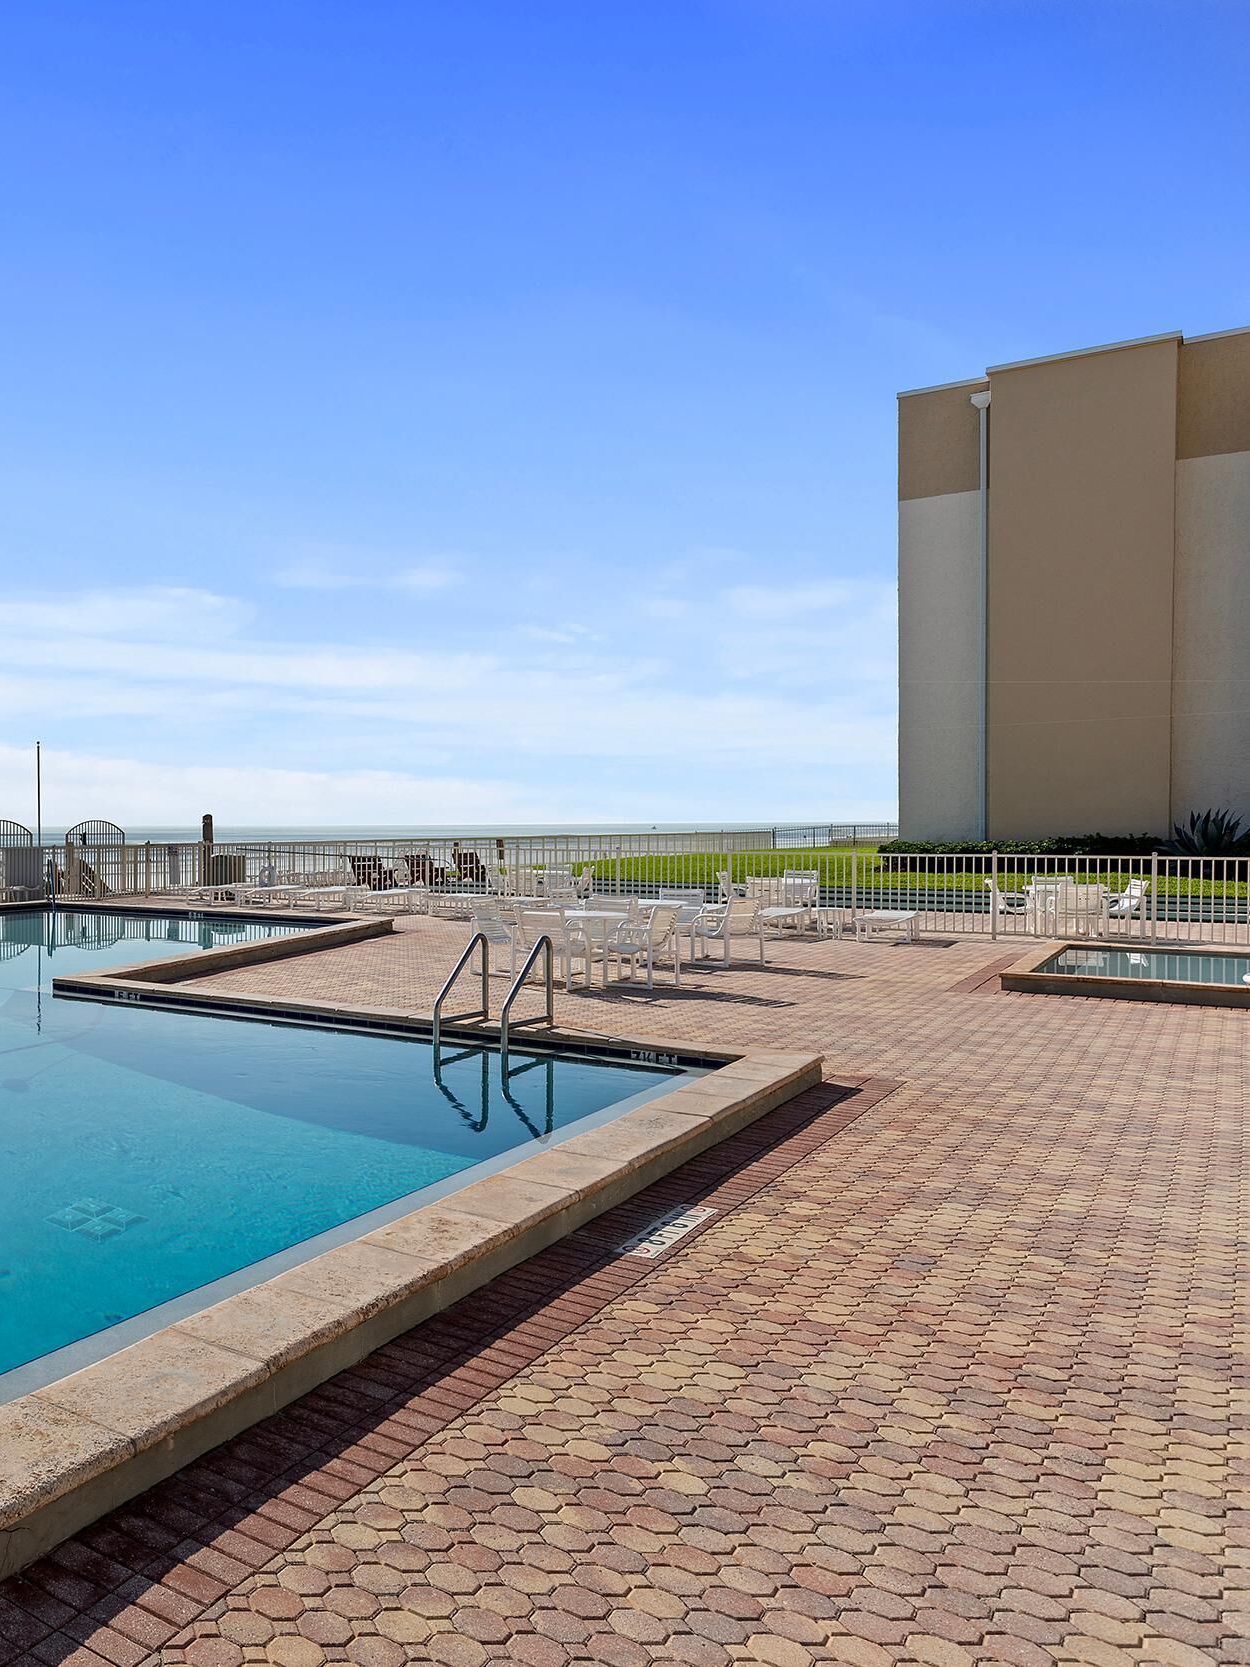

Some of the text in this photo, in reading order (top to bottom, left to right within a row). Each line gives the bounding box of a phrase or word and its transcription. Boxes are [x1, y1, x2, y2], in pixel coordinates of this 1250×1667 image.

[660, 1220, 689, 1229] 6
[645, 1227, 680, 1240] FT
[637, 1237, 666, 1246] 8
